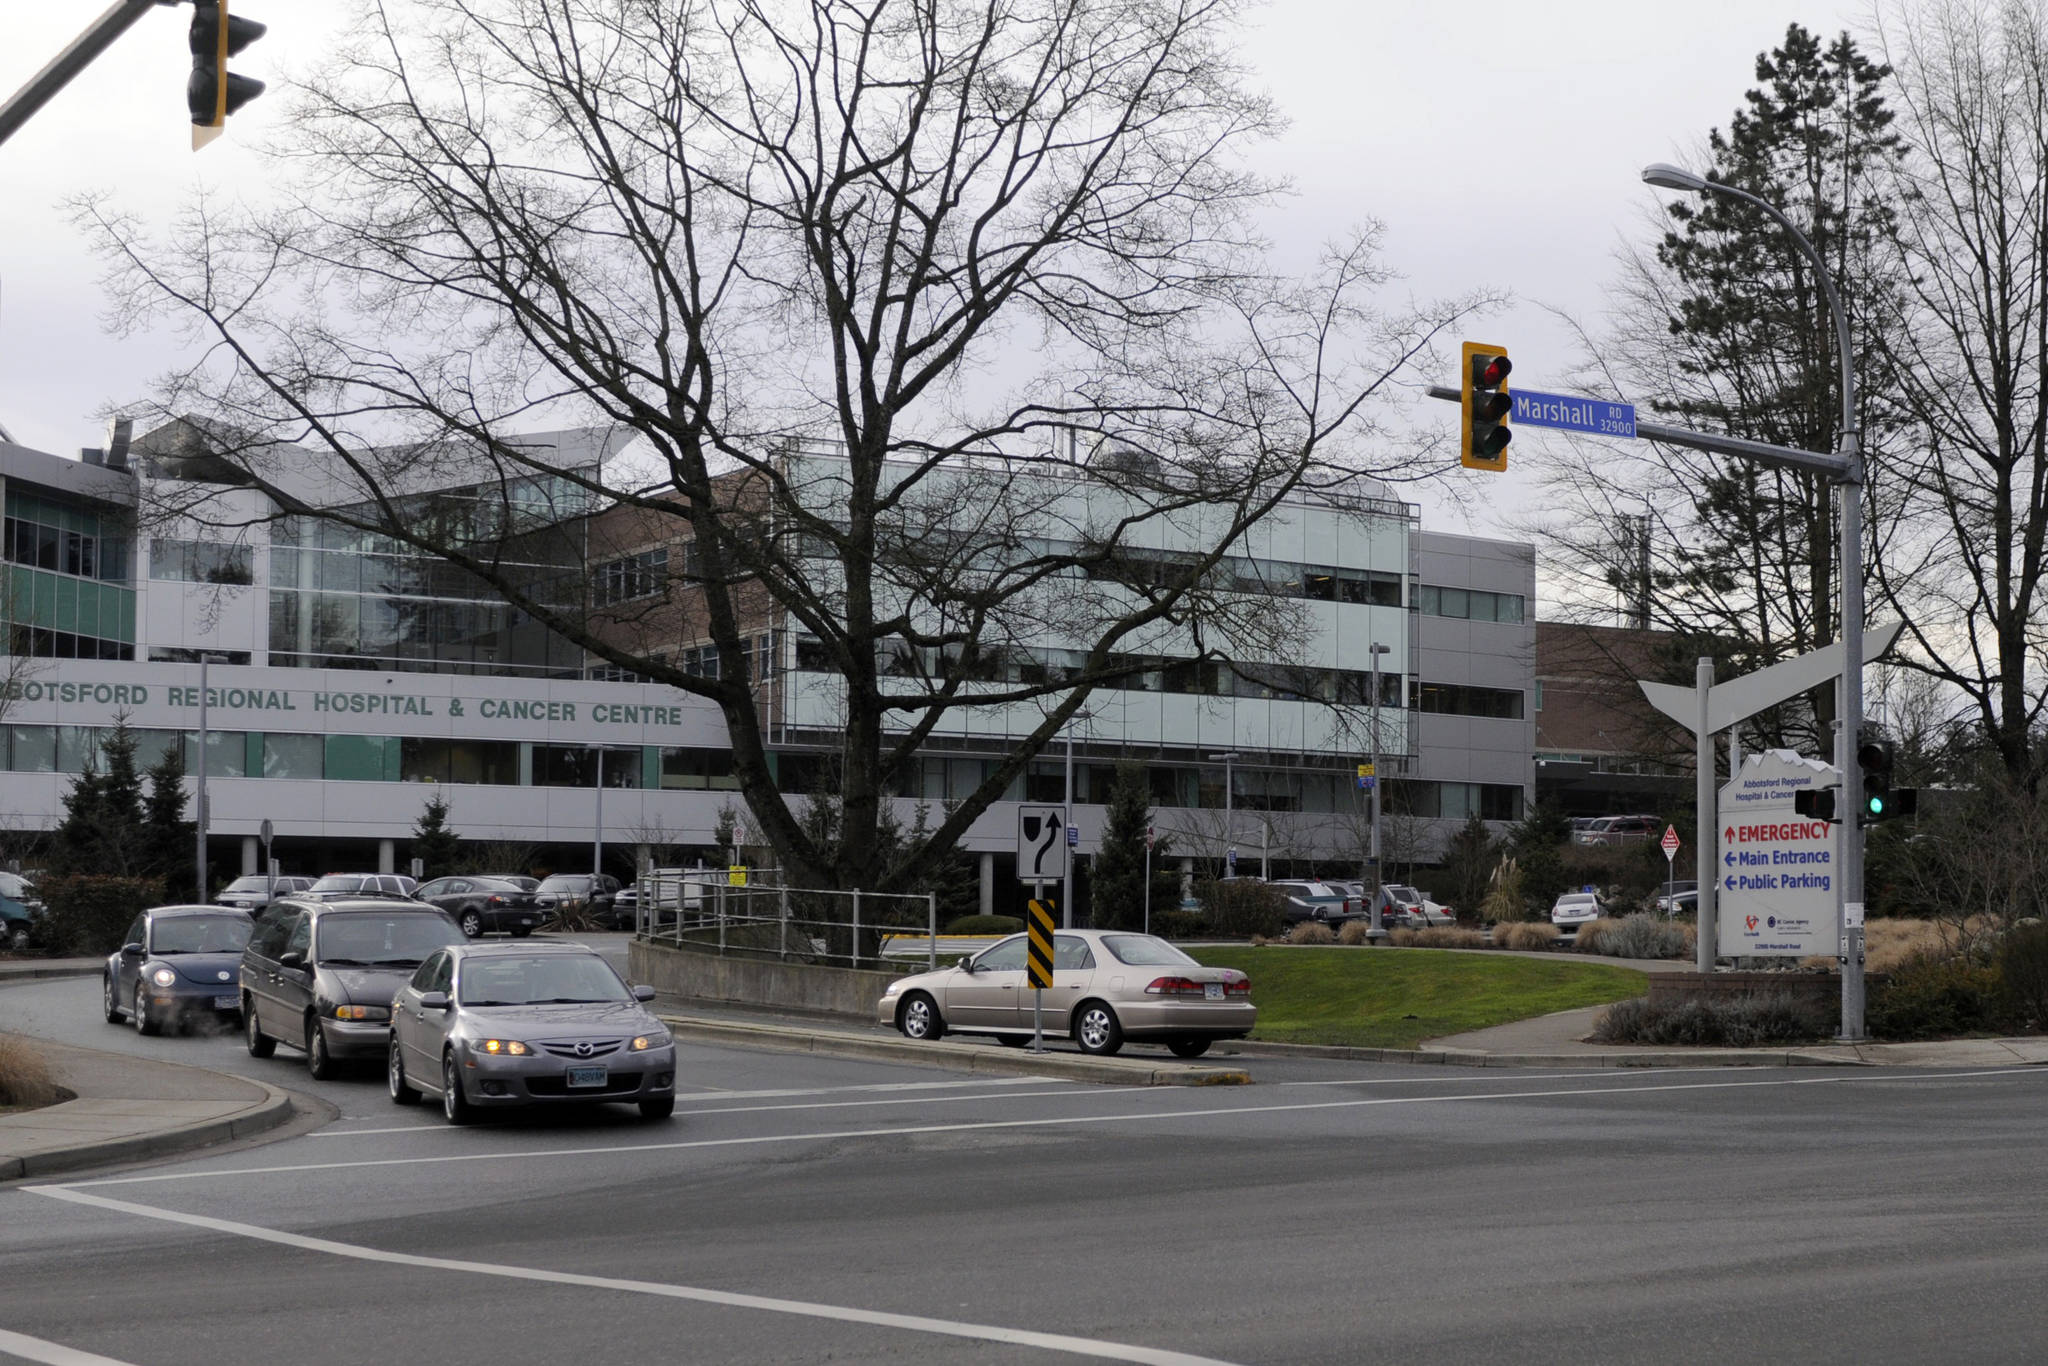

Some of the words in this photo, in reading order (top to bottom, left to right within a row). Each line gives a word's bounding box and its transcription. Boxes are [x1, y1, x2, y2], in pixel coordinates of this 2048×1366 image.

[1517, 397, 1595, 426] Marshall
[1609, 407, 1623, 419] RD
[1600, 419, 1633, 434] 32900
[0, 681, 148, 705] BOTSFORD
[168, 687, 297, 711] REGIONAL
[314, 692, 433, 716] HOSPITAL
[449, 698, 464, 717] &
[480, 699, 576, 721] CANCER
[592, 704, 682, 725] CENTRE
[1743, 778, 1780, 789] Abbotsford
[1782, 776, 1812, 787] Regional
[1735, 791, 1763, 802] Hospital
[1764, 791, 1769, 800] &
[1770, 790, 1795, 799] Cancer
[1738, 821, 1830, 842] EMERGENCY
[1739, 850, 1769, 866] Main
[1773, 850, 1830, 865] Entrance
[1739, 873, 1778, 890] Public
[1781, 872, 1831, 891] Parking
